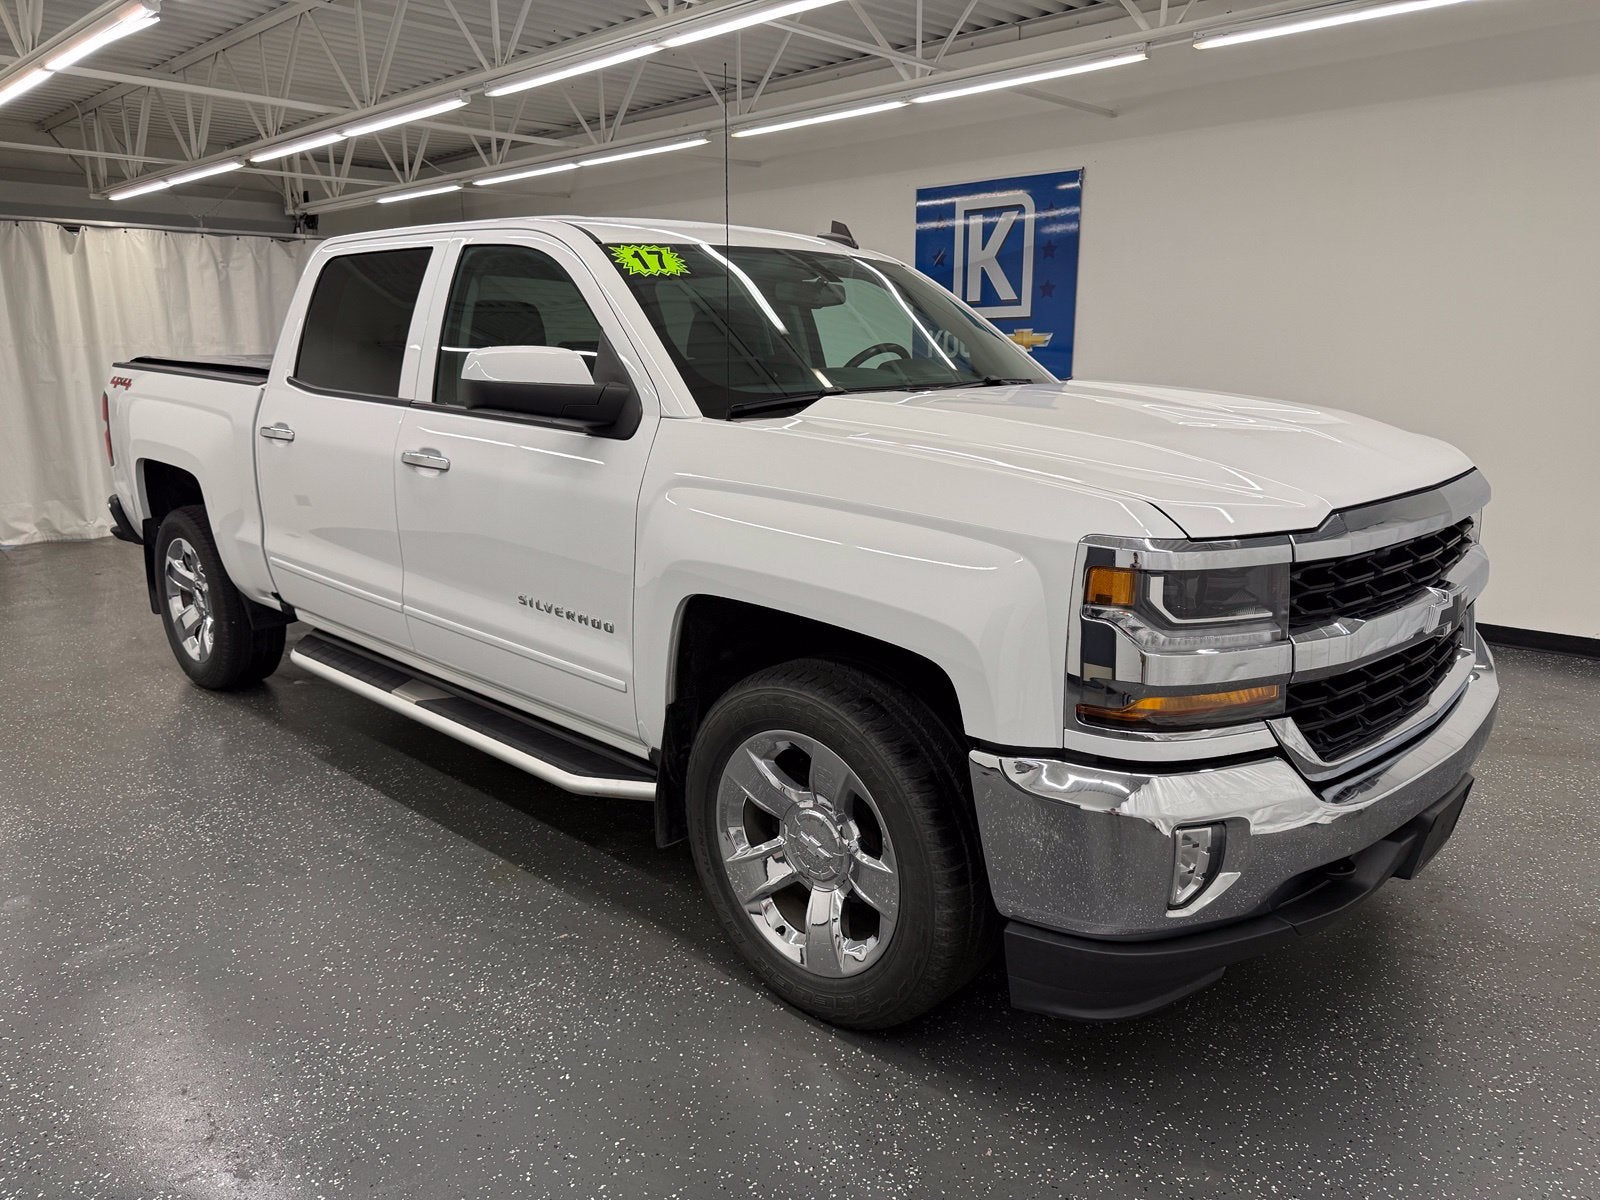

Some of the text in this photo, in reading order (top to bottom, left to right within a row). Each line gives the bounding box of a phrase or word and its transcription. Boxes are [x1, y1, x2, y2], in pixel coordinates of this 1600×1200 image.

[630, 249, 667, 270] 17
[967, 210, 1020, 302] K
[518, 594, 615, 634] SILVERADO
